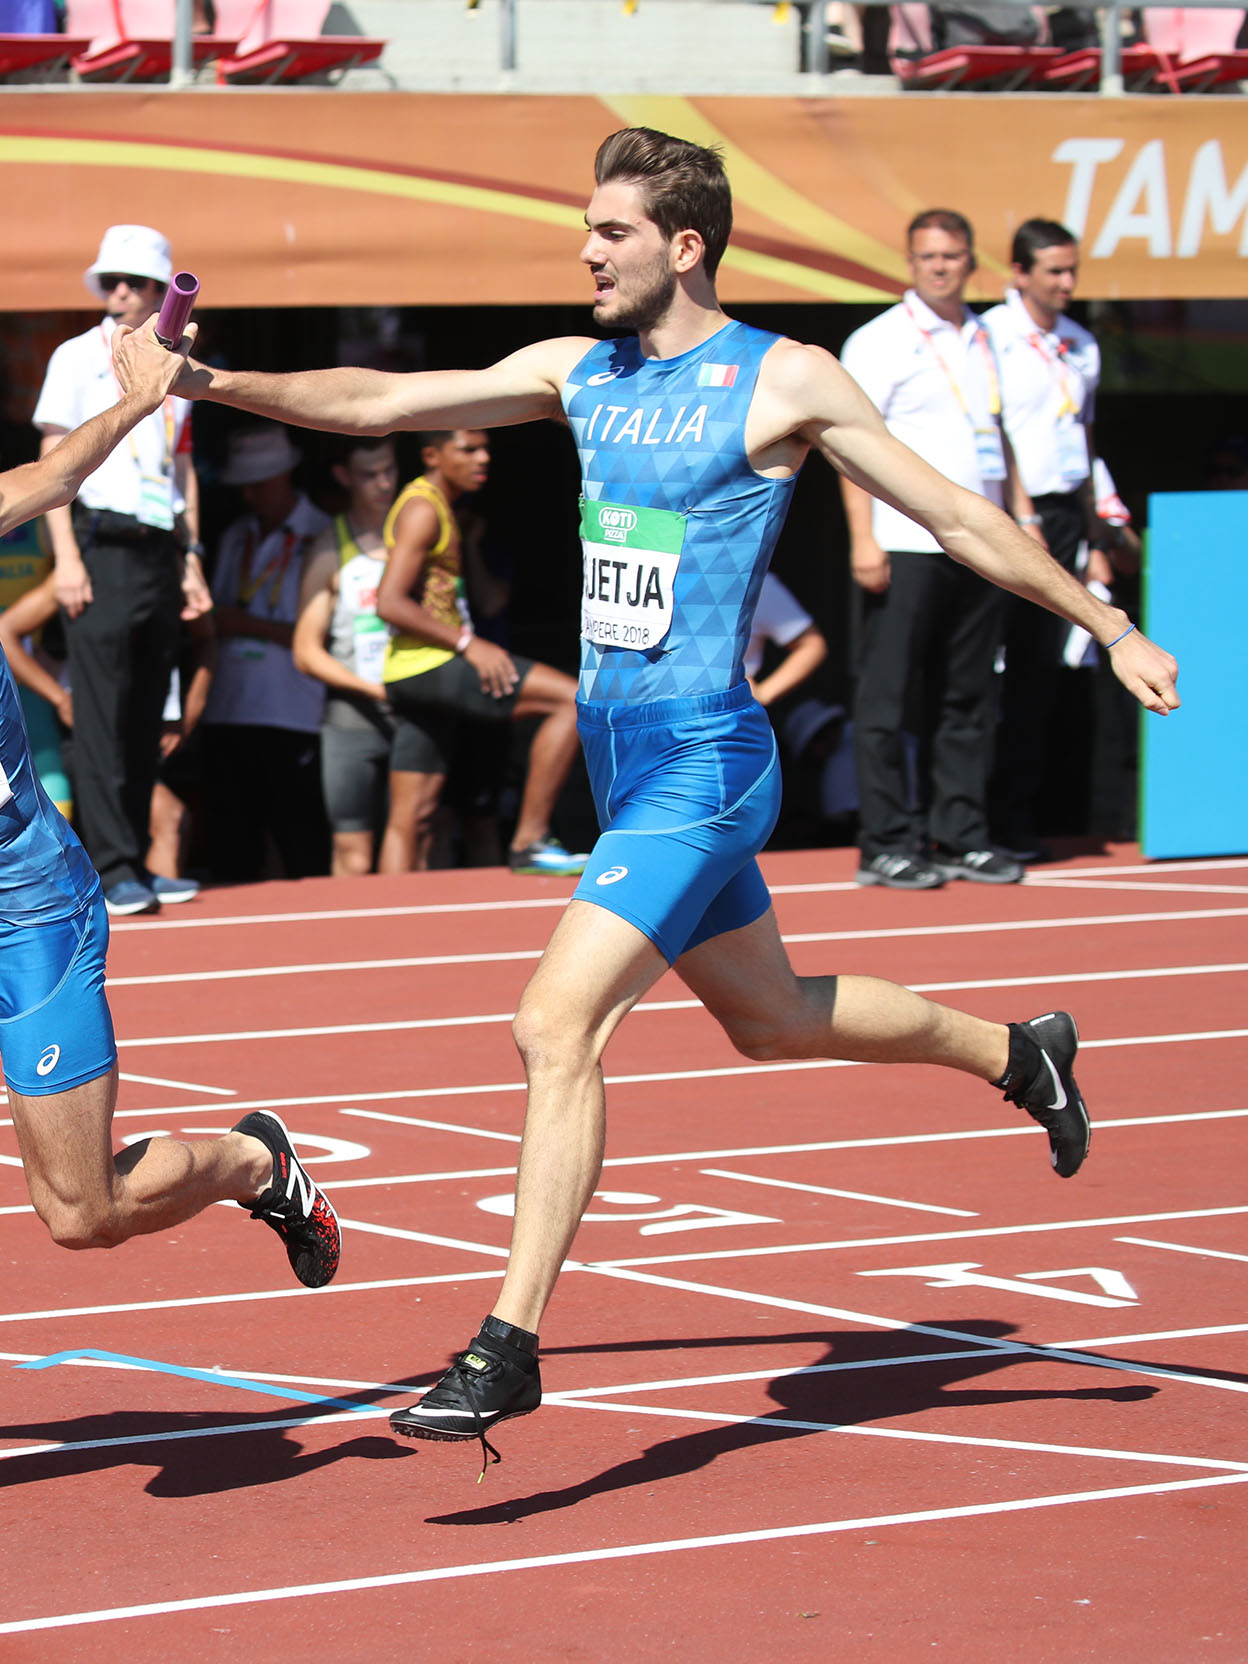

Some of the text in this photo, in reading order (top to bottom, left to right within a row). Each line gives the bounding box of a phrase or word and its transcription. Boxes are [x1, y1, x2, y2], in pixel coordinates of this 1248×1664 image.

[1051, 137, 1248, 259] TAM
[586, 403, 708, 445] ITALIA
[602, 510, 633, 528] KOTI
[623, 625, 650, 645] 2018
[855, 1262, 1143, 1308] 4
